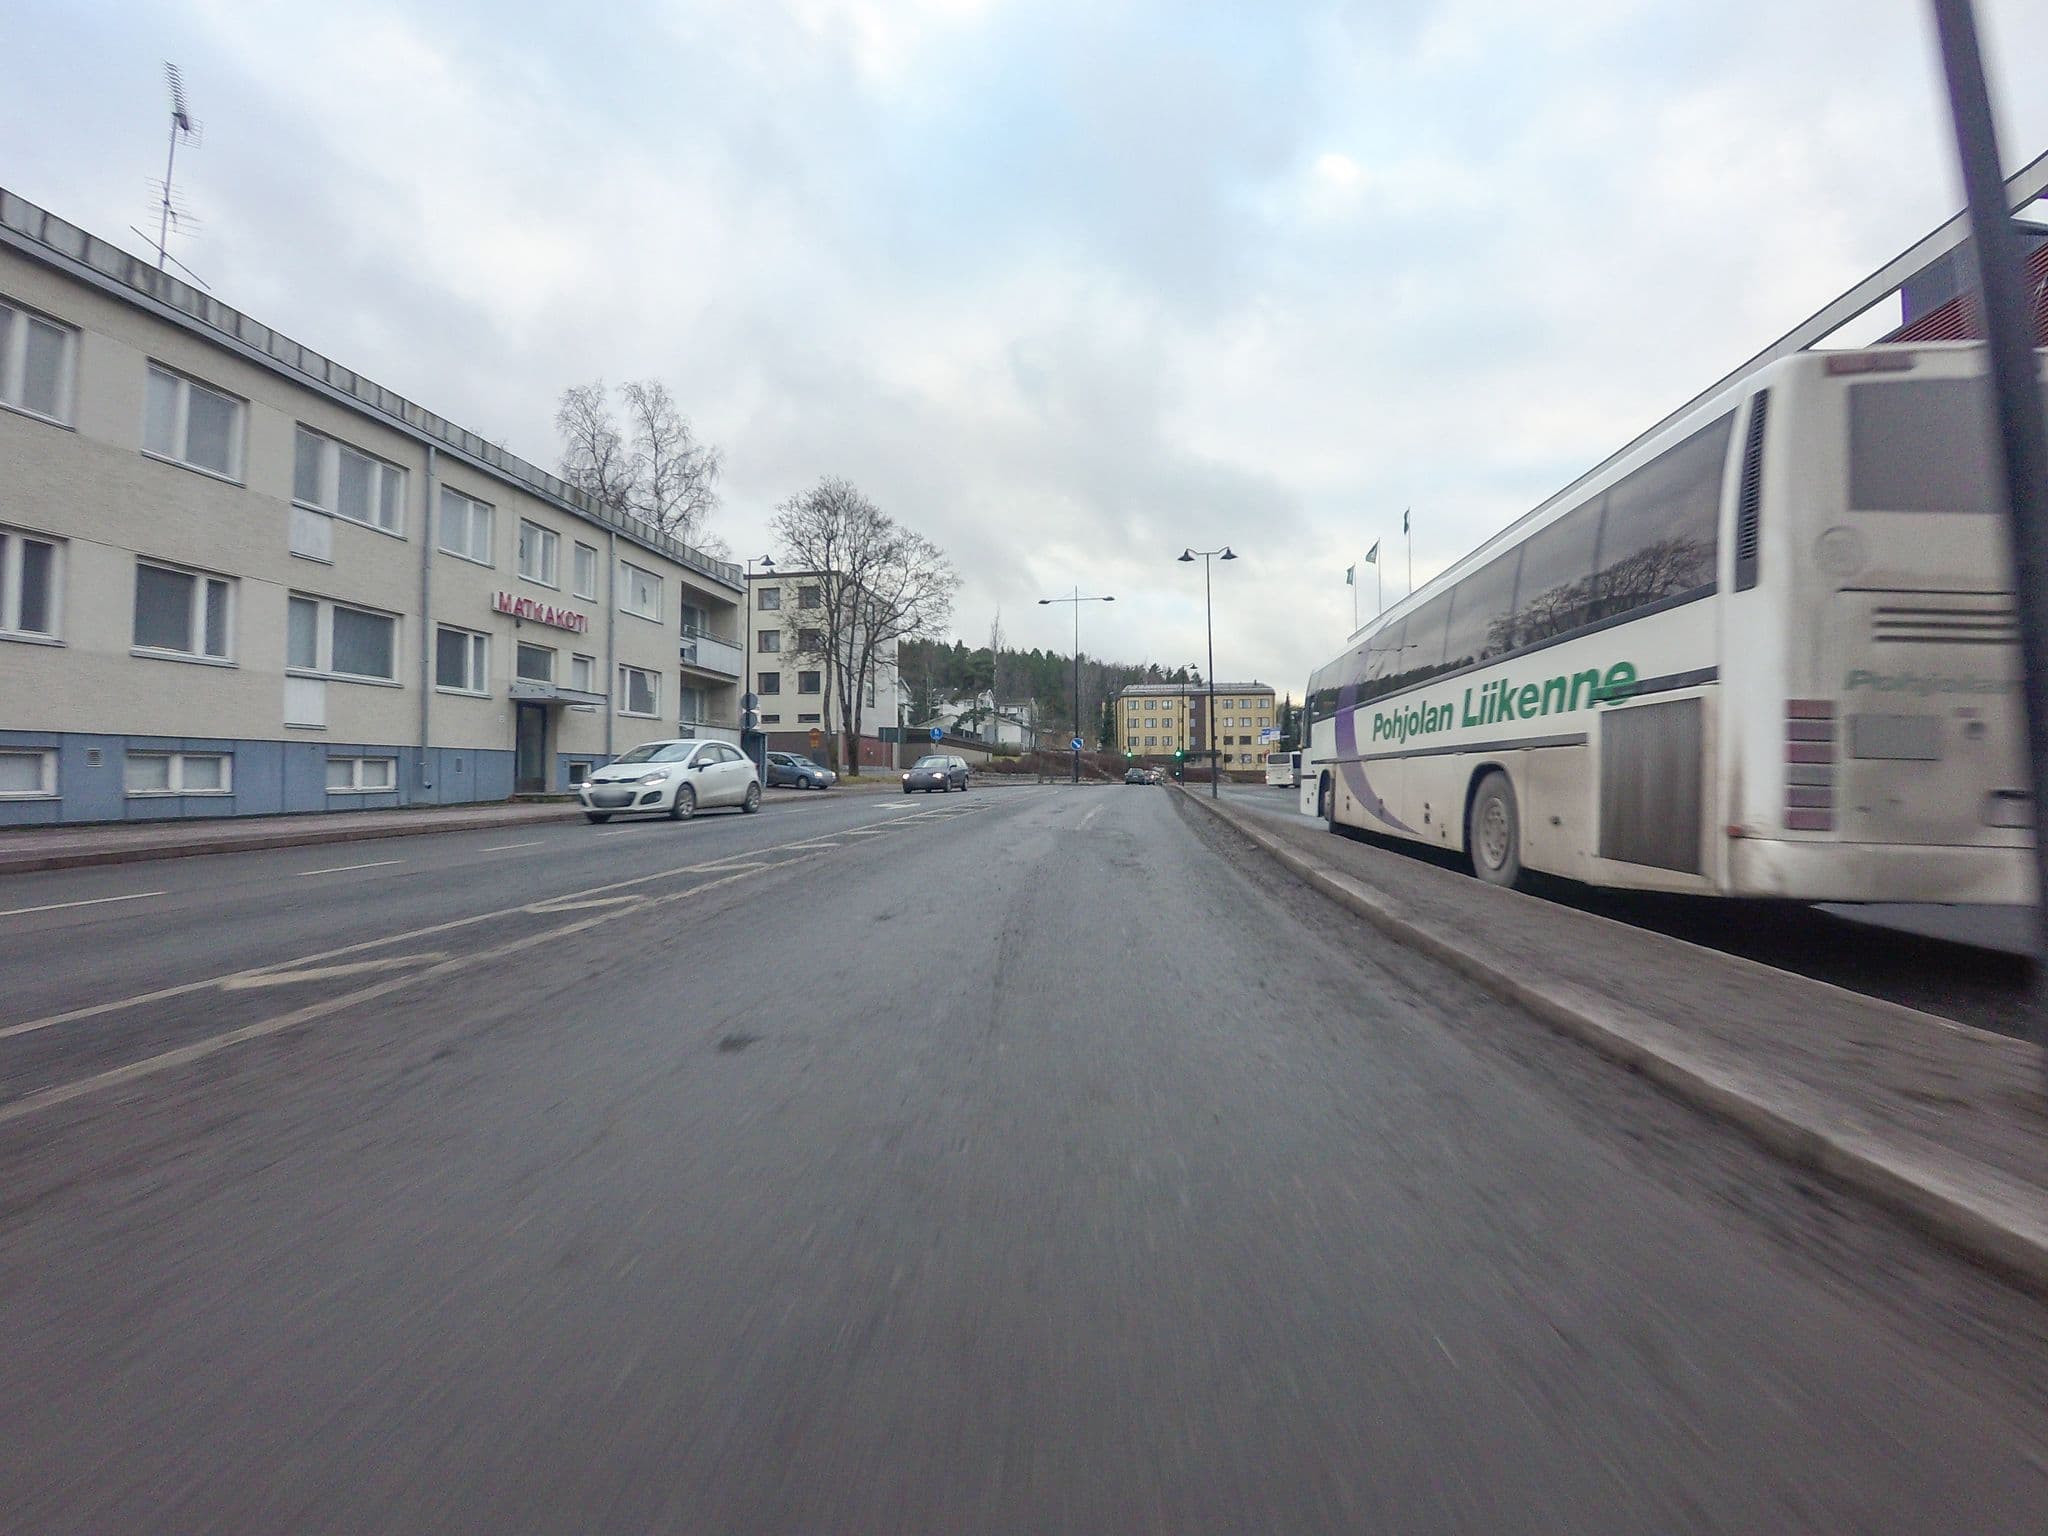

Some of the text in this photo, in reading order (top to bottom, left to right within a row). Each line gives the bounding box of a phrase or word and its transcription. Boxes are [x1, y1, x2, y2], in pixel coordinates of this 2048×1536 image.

[499, 591, 589, 633] MATKAKOTI
[1372, 661, 1636, 744] Pohjolan Liikenne
